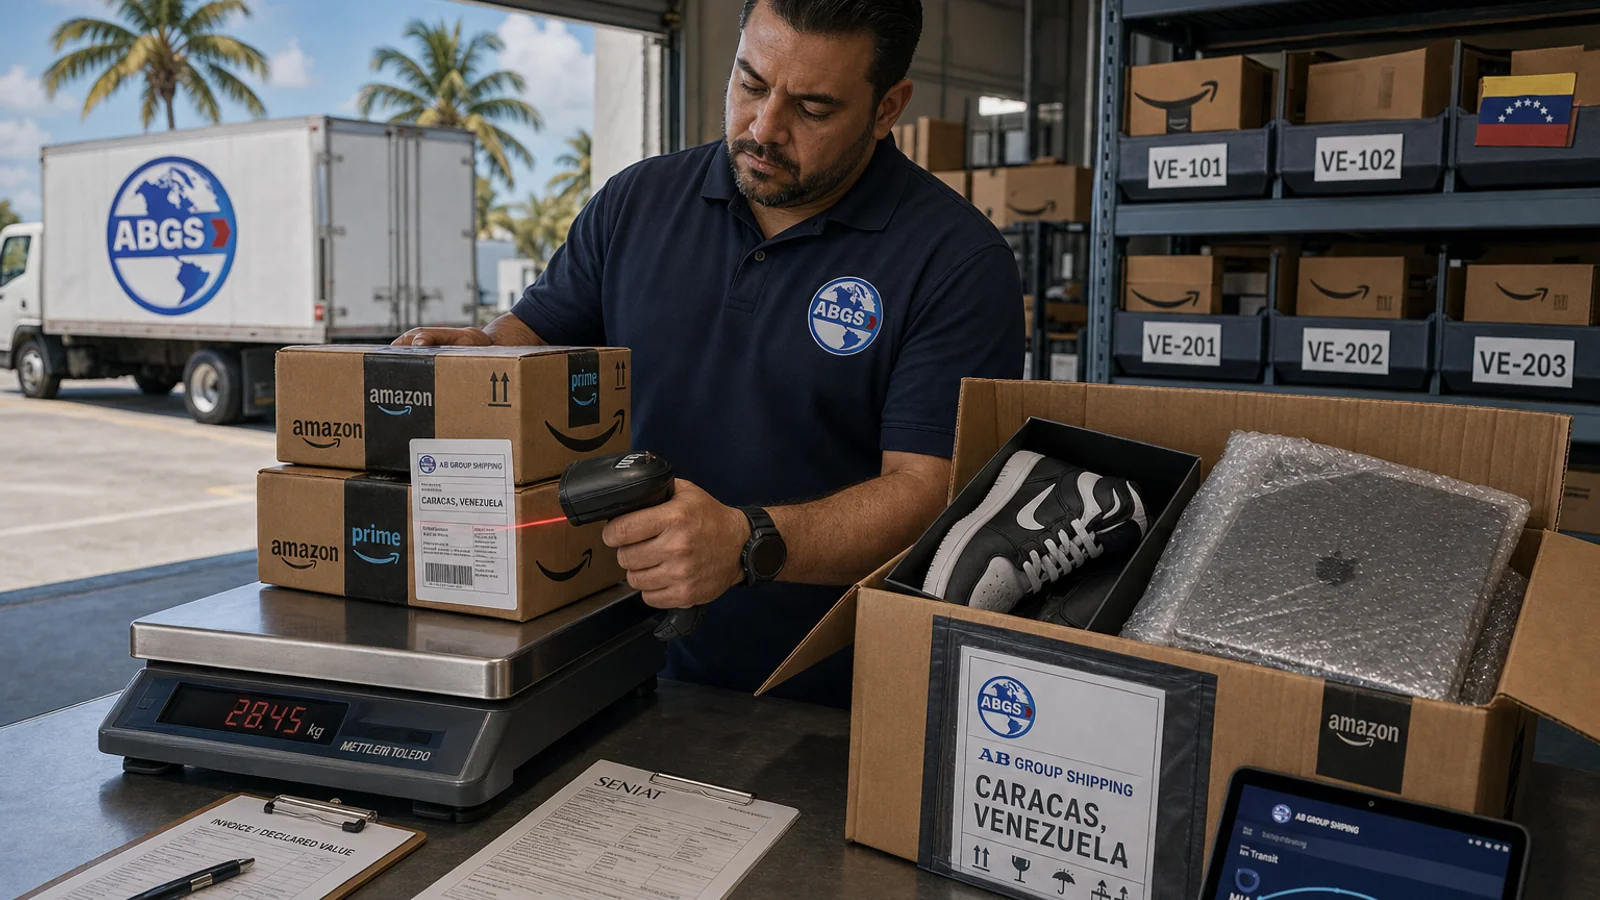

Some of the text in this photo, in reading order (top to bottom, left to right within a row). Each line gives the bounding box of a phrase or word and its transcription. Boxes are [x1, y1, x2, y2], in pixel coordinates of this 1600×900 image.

[1153, 156, 1223, 181] VE-101
[1321, 148, 1396, 173] VE-102
[113, 217, 205, 251] ABGS
[812, 301, 865, 326] ABGS
[1147, 333, 1217, 358] VE-201
[1307, 340, 1383, 366] VE-202
[1479, 350, 1566, 378] VE-203
[571, 368, 597, 391] prime
[369, 387, 432, 407] amazon
[292, 419, 363, 439] amazon
[450, 461, 471, 469] GROUP
[473, 462, 503, 470] SHIPPING
[421, 496, 503, 507] CARACAS, VENEZUELA
[352, 524, 401, 547] prime
[271, 539, 339, 562] amazon
[981, 695, 1022, 716] ABGS
[225, 699, 325, 739] 28.45 kg
[1328, 713, 1399, 743] amazon
[391, 747, 431, 761] TOLEDO
[978, 748, 1134, 798] AB GROUP SHIPPING
[594, 776, 666, 800] SENIAT
[975, 774, 1107, 834] CARACAS,
[1306, 815, 1330, 827] GROUP
[973, 803, 1129, 869] VENEZUELA
[319, 842, 355, 857] VALUE
[1250, 849, 1279, 864] Transit
